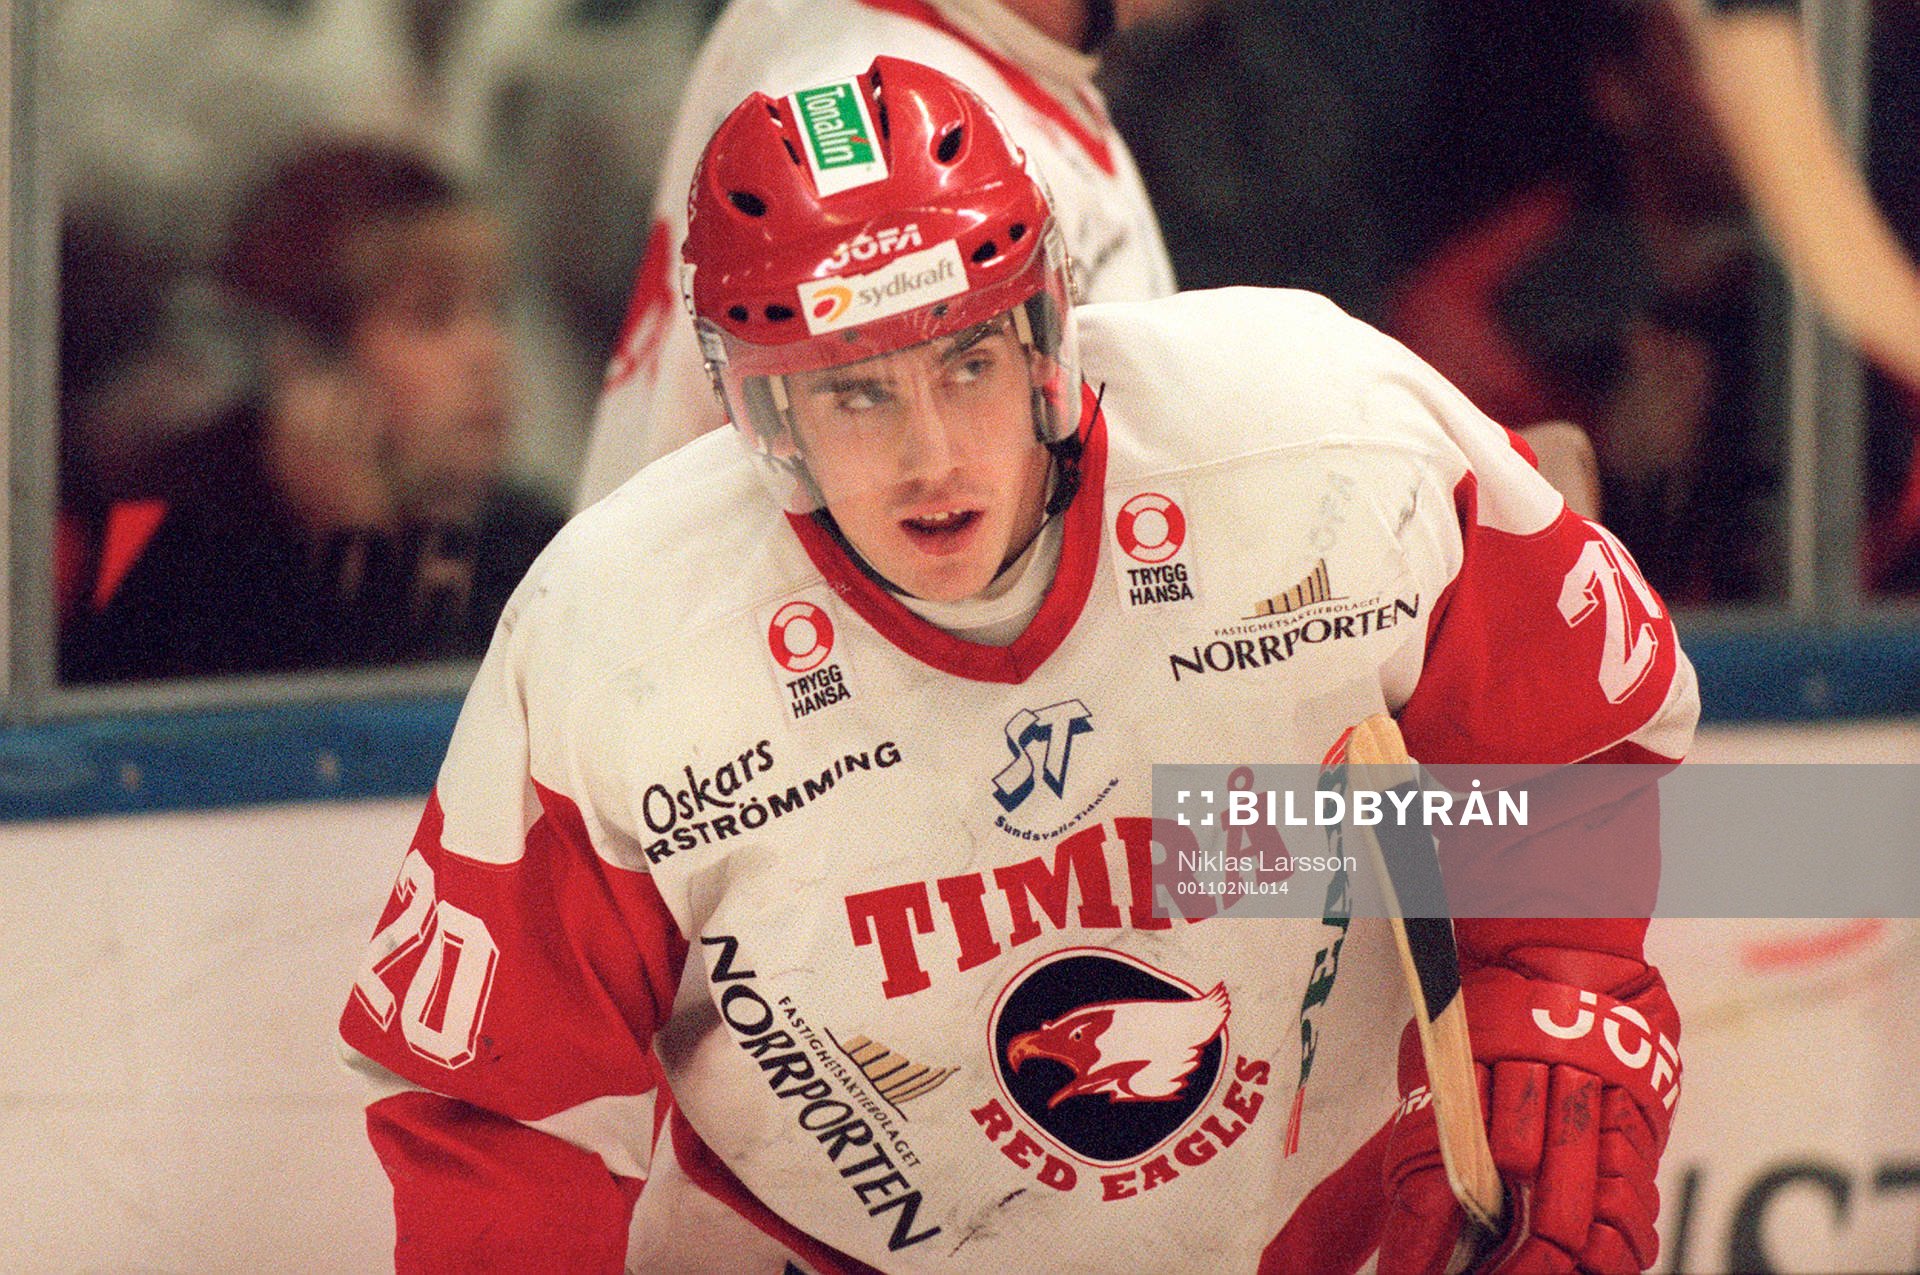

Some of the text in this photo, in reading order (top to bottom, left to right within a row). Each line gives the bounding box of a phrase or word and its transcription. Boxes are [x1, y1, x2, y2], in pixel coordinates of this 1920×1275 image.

[804, 86, 862, 164] Tonalin
[820, 224, 922, 270] JOFA
[857, 259, 954, 306] sydkraft
[1127, 564, 1188, 587] TRYGG
[1130, 583, 1194, 606] HANSA
[786, 664, 843, 699] TRYGG
[1169, 593, 1420, 682] NORRPORTEN
[792, 682, 851, 719] HANSA
[642, 739, 774, 834] Oskars
[992, 699, 1094, 812] ST
[844, 766, 1295, 1000] TIMRÅ
[353, 848, 500, 1070] 20
[701, 935, 942, 1252] NORRPORTEN
[778, 996, 921, 1168] FASTIGHETSAKTIEBOLAGET
[970, 1055, 1271, 1201] RED EAGLES
